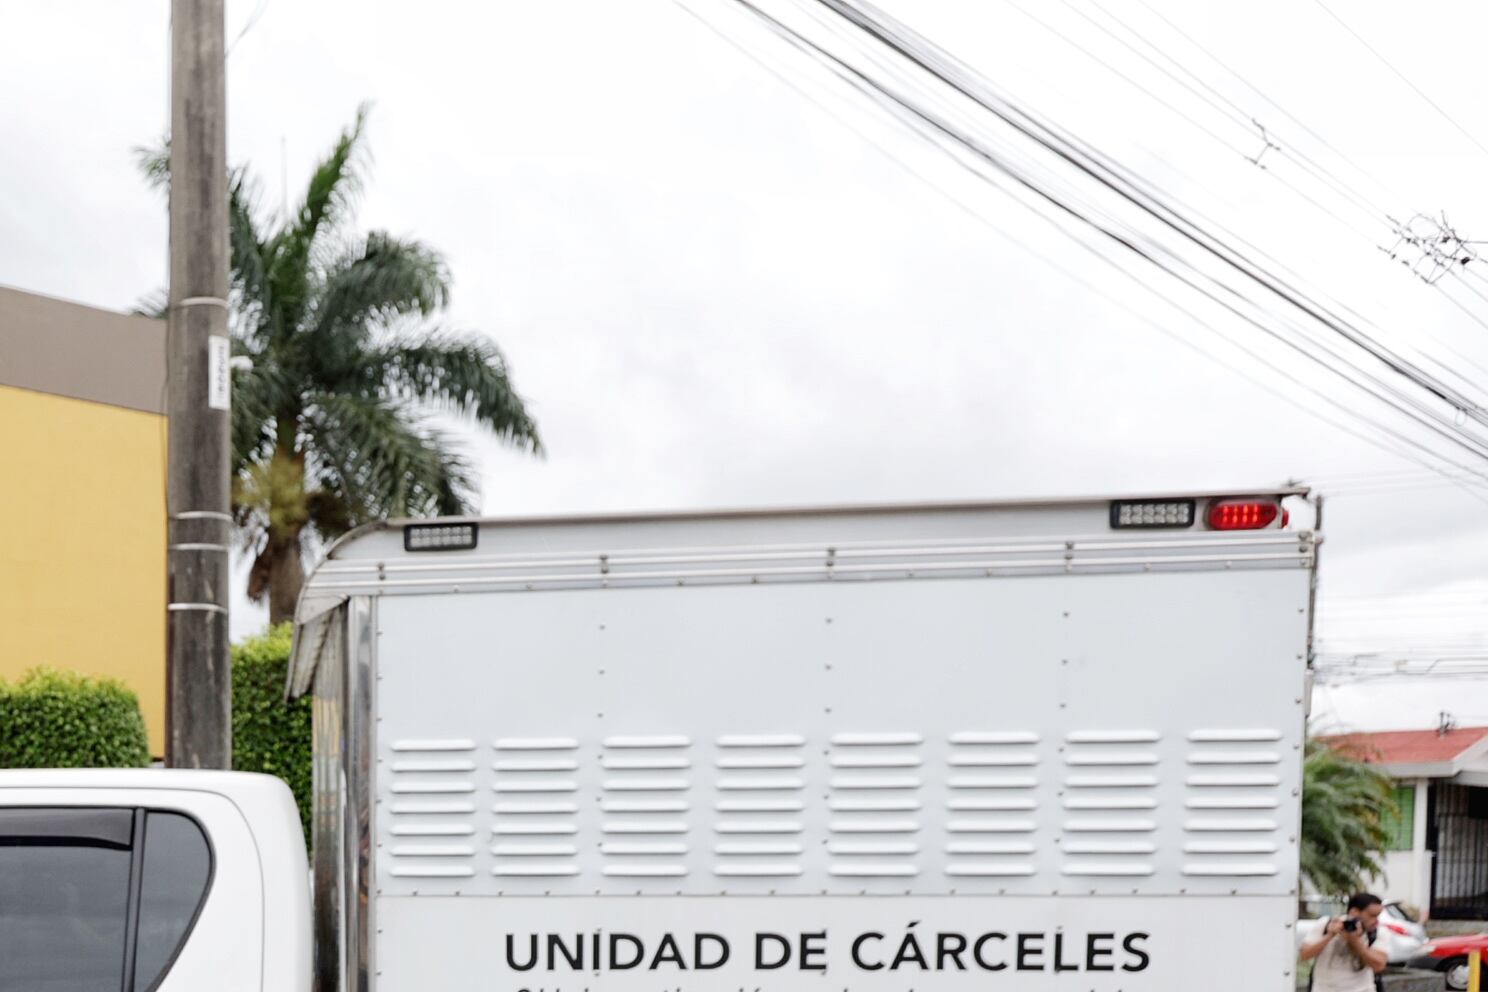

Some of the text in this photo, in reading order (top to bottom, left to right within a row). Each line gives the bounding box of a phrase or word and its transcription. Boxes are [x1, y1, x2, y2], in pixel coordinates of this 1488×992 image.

[505, 922, 1150, 973] UNIDAD DE CÁRCELES
